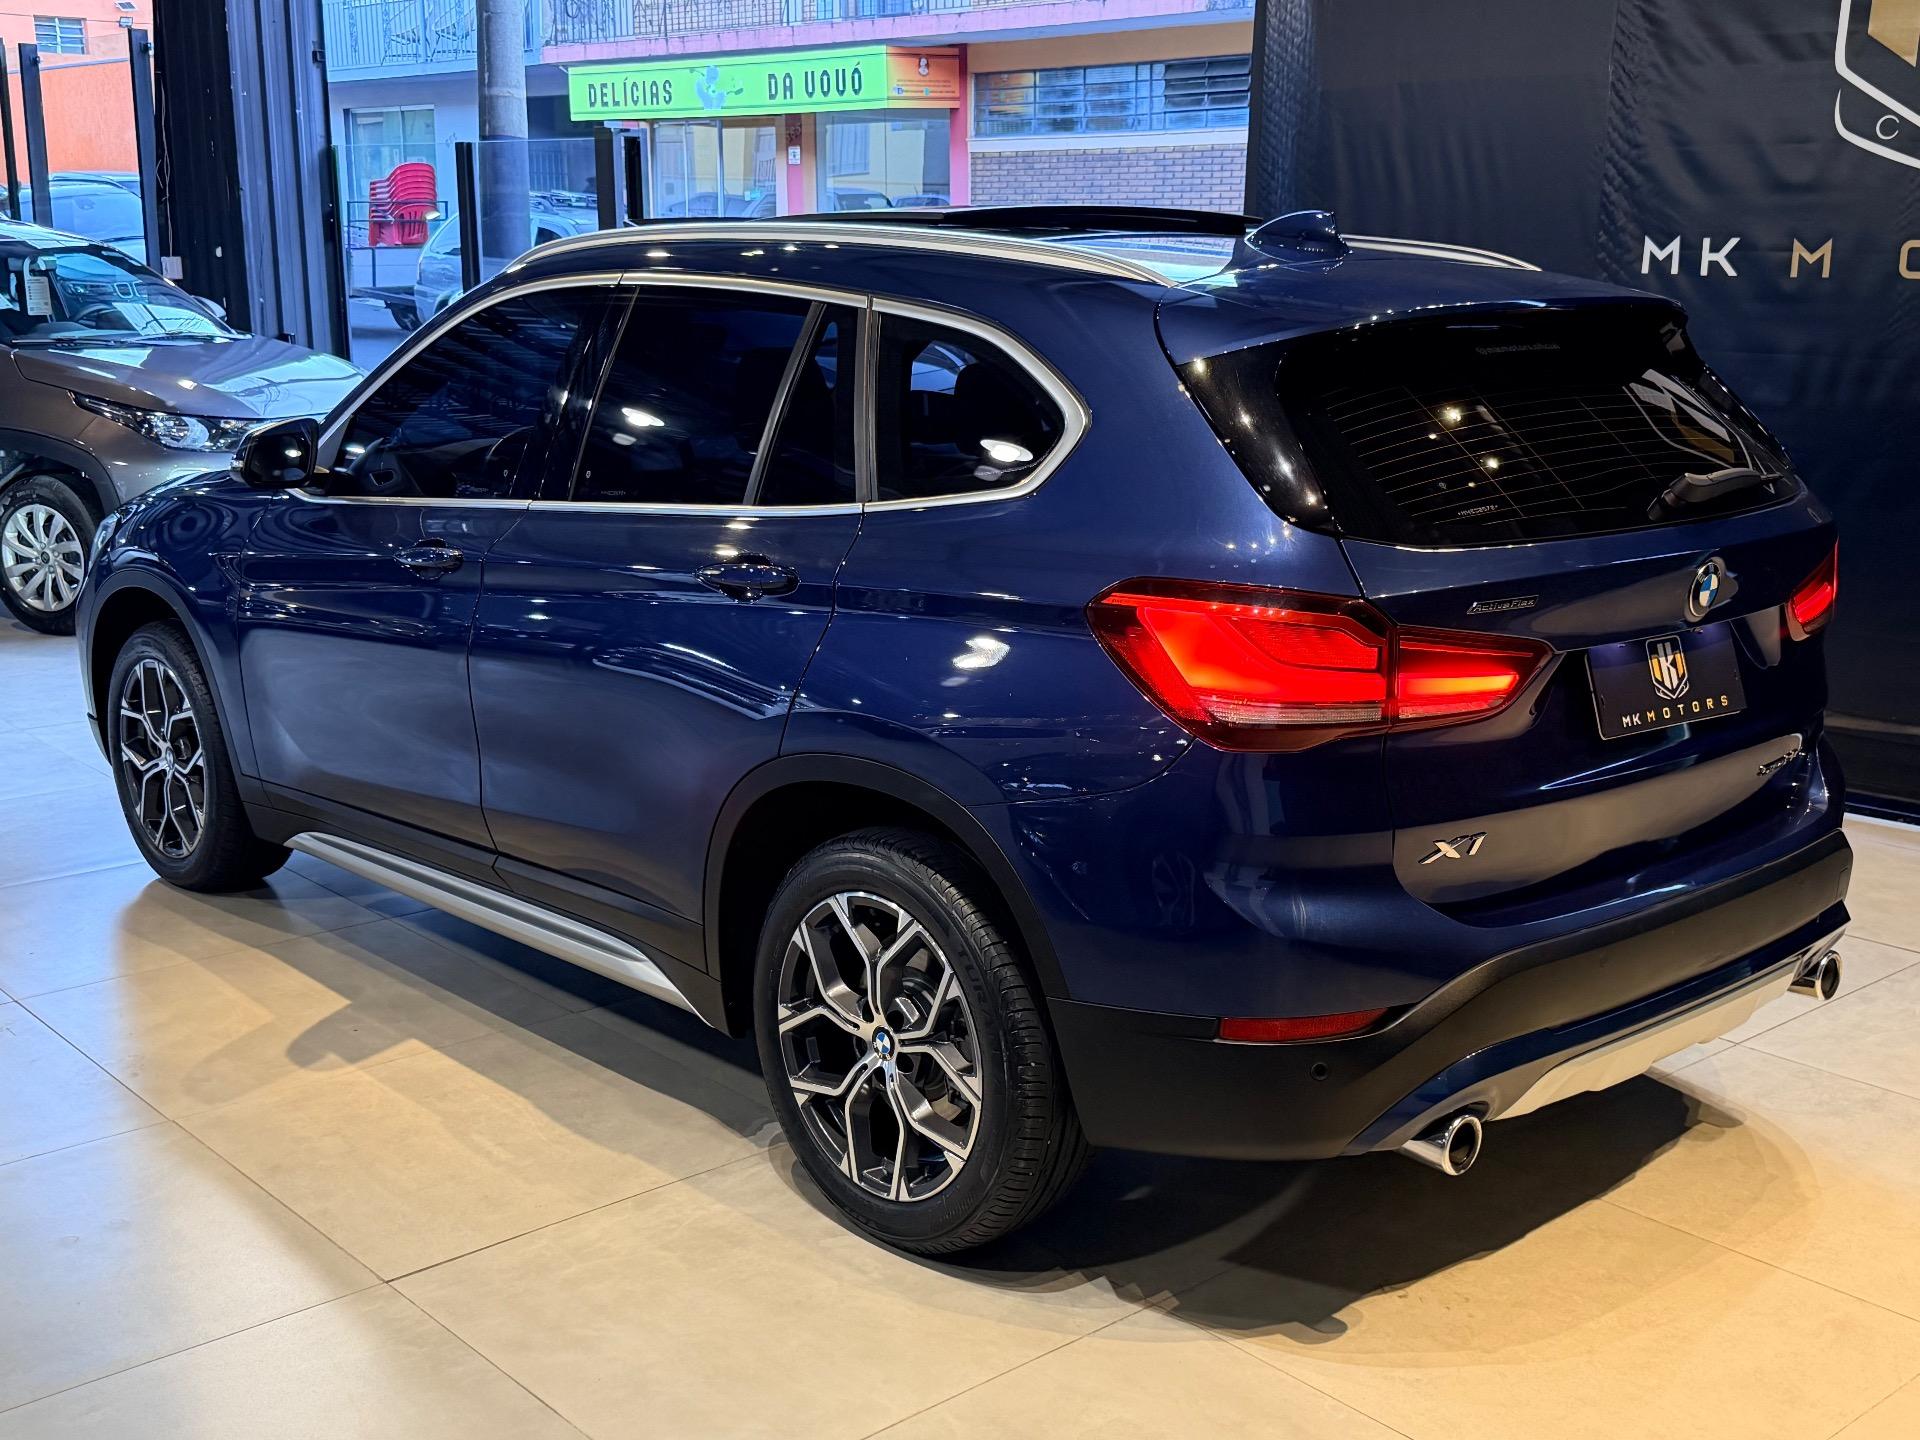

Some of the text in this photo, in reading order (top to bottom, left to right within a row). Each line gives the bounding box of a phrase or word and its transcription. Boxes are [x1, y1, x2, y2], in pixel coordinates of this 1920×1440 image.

[588, 77, 672, 108] DELÍCIAS
[768, 73, 793, 100] DA
[1641, 235, 1741, 277] MK
[1622, 695, 1729, 728] MK MOTORS
